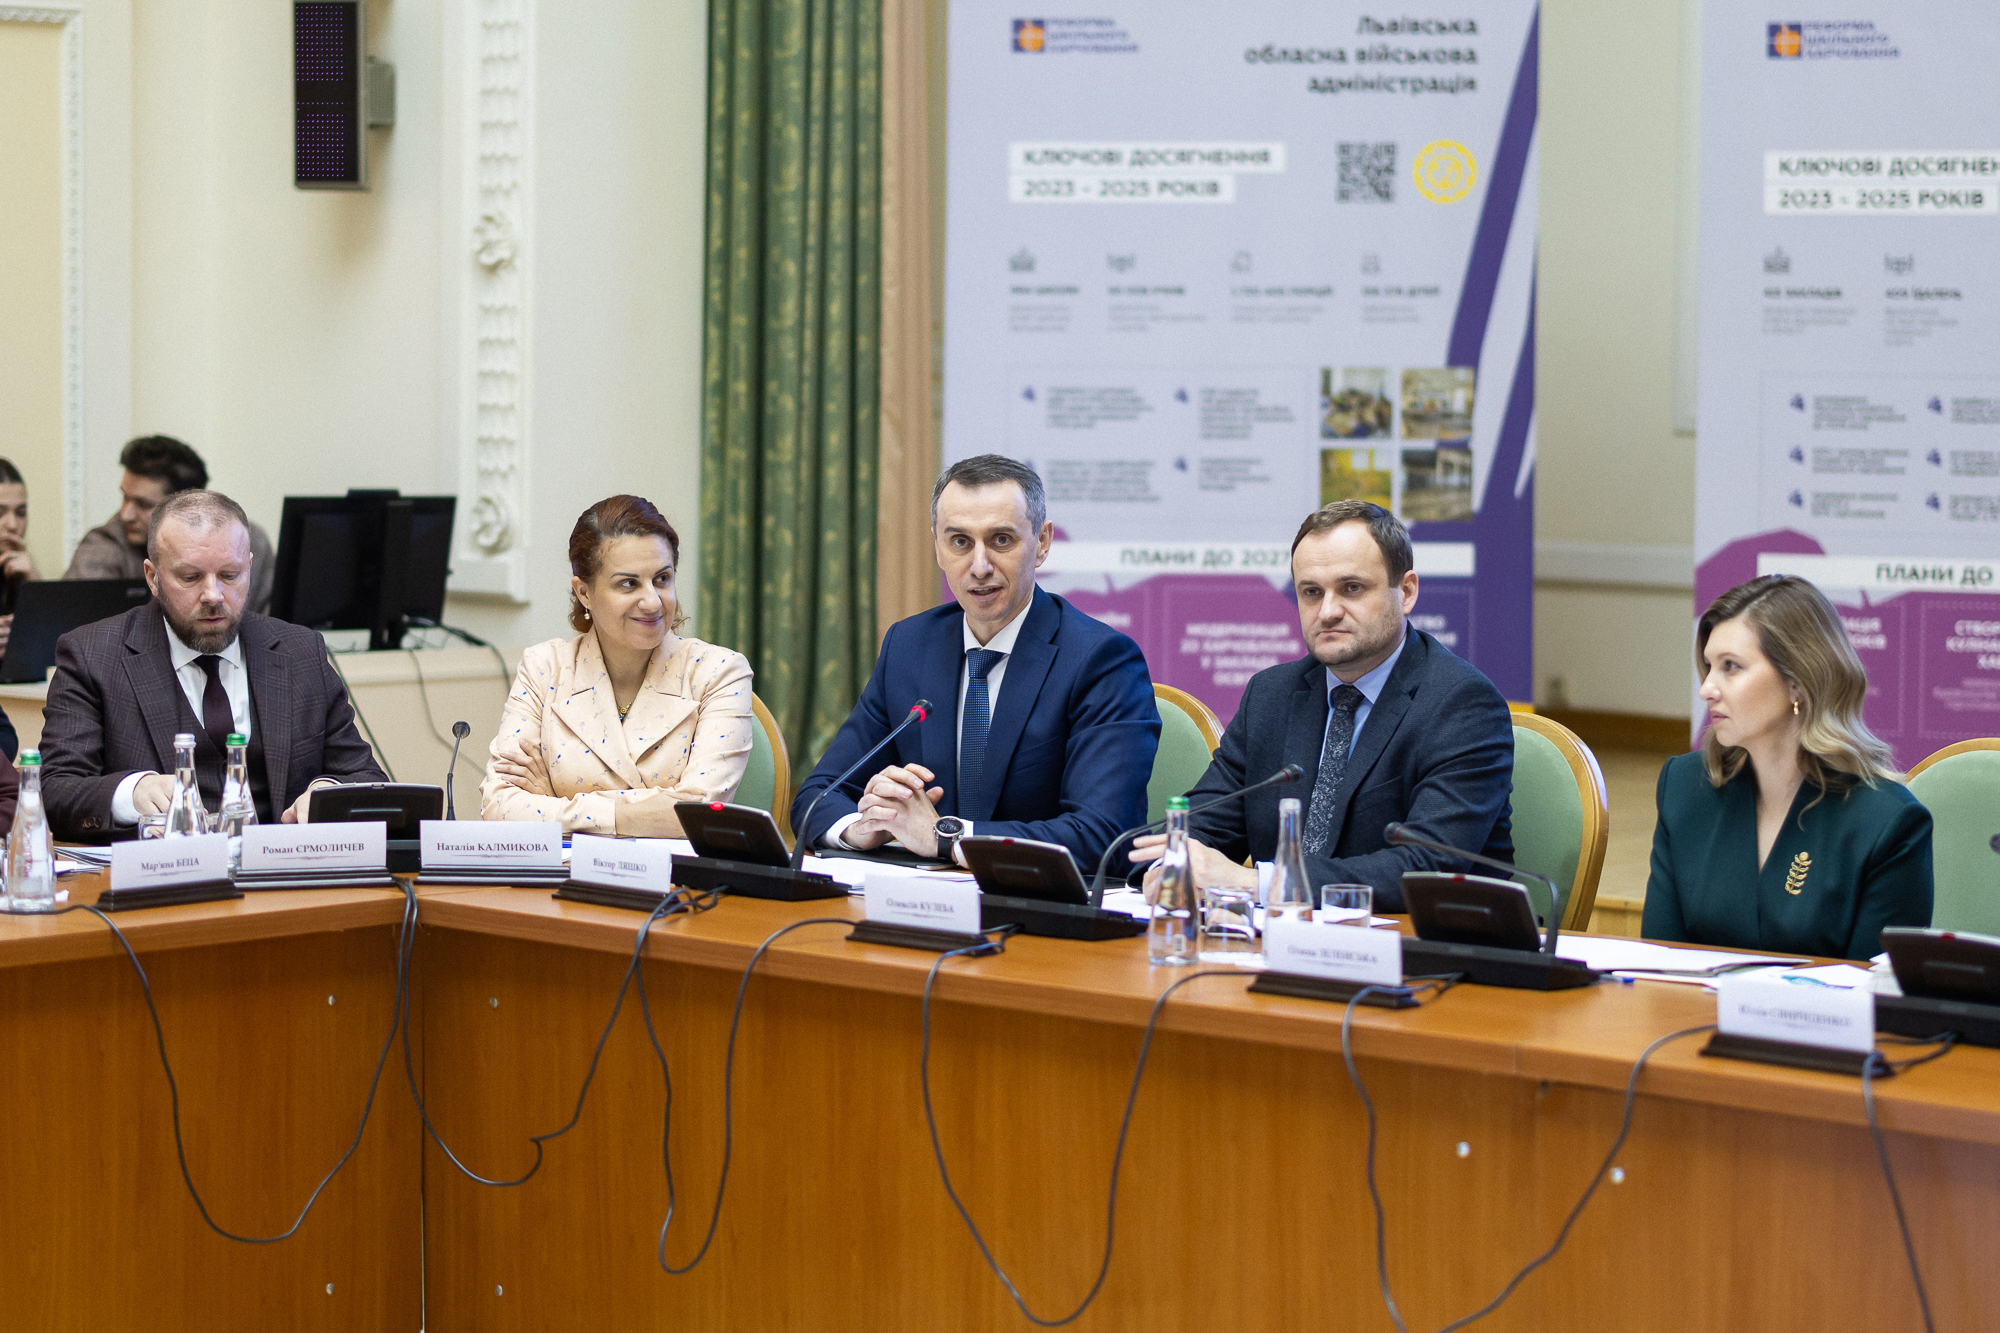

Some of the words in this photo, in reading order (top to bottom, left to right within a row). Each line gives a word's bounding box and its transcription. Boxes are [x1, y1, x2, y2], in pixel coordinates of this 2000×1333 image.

[1357, 15, 1478, 36] Львівська
[1244, 43, 1347, 65] обласна
[1355, 44, 1478, 66] військова
[1308, 72, 1478, 95] адміністрація
[1023, 147, 1121, 167] КЛЮЧОВІ
[1128, 149, 1271, 170] ДОСЯГНЕННЯ
[1778, 156, 1881, 176] КЛЮЧОВІ
[1023, 180, 1075, 197] 2023
[1099, 180, 1151, 197] 2025
[1157, 180, 1221, 197] РОКІВ
[1779, 190, 1833, 208] 2023
[1857, 190, 1911, 208] 2025
[1918, 190, 1985, 208] РОКІВ
[1120, 549, 1196, 565] ПЛАНИ
[1202, 550, 1234, 567] ДО
[1876, 566, 1953, 583] ПЛАНИ
[1960, 566, 1994, 586] ДО
[262, 844, 294, 857] Роман
[295, 841, 365, 855] ЄРМОЛИЧЕВ
[436, 841, 475, 851] Наталія
[477, 842, 550, 854] КАЛМИКОВА
[141, 860, 175, 874] Мар'яна
[176, 857, 200, 869] БЕЦА
[593, 857, 616, 871] Віктор
[617, 860, 648, 873] ЛЯШКО
